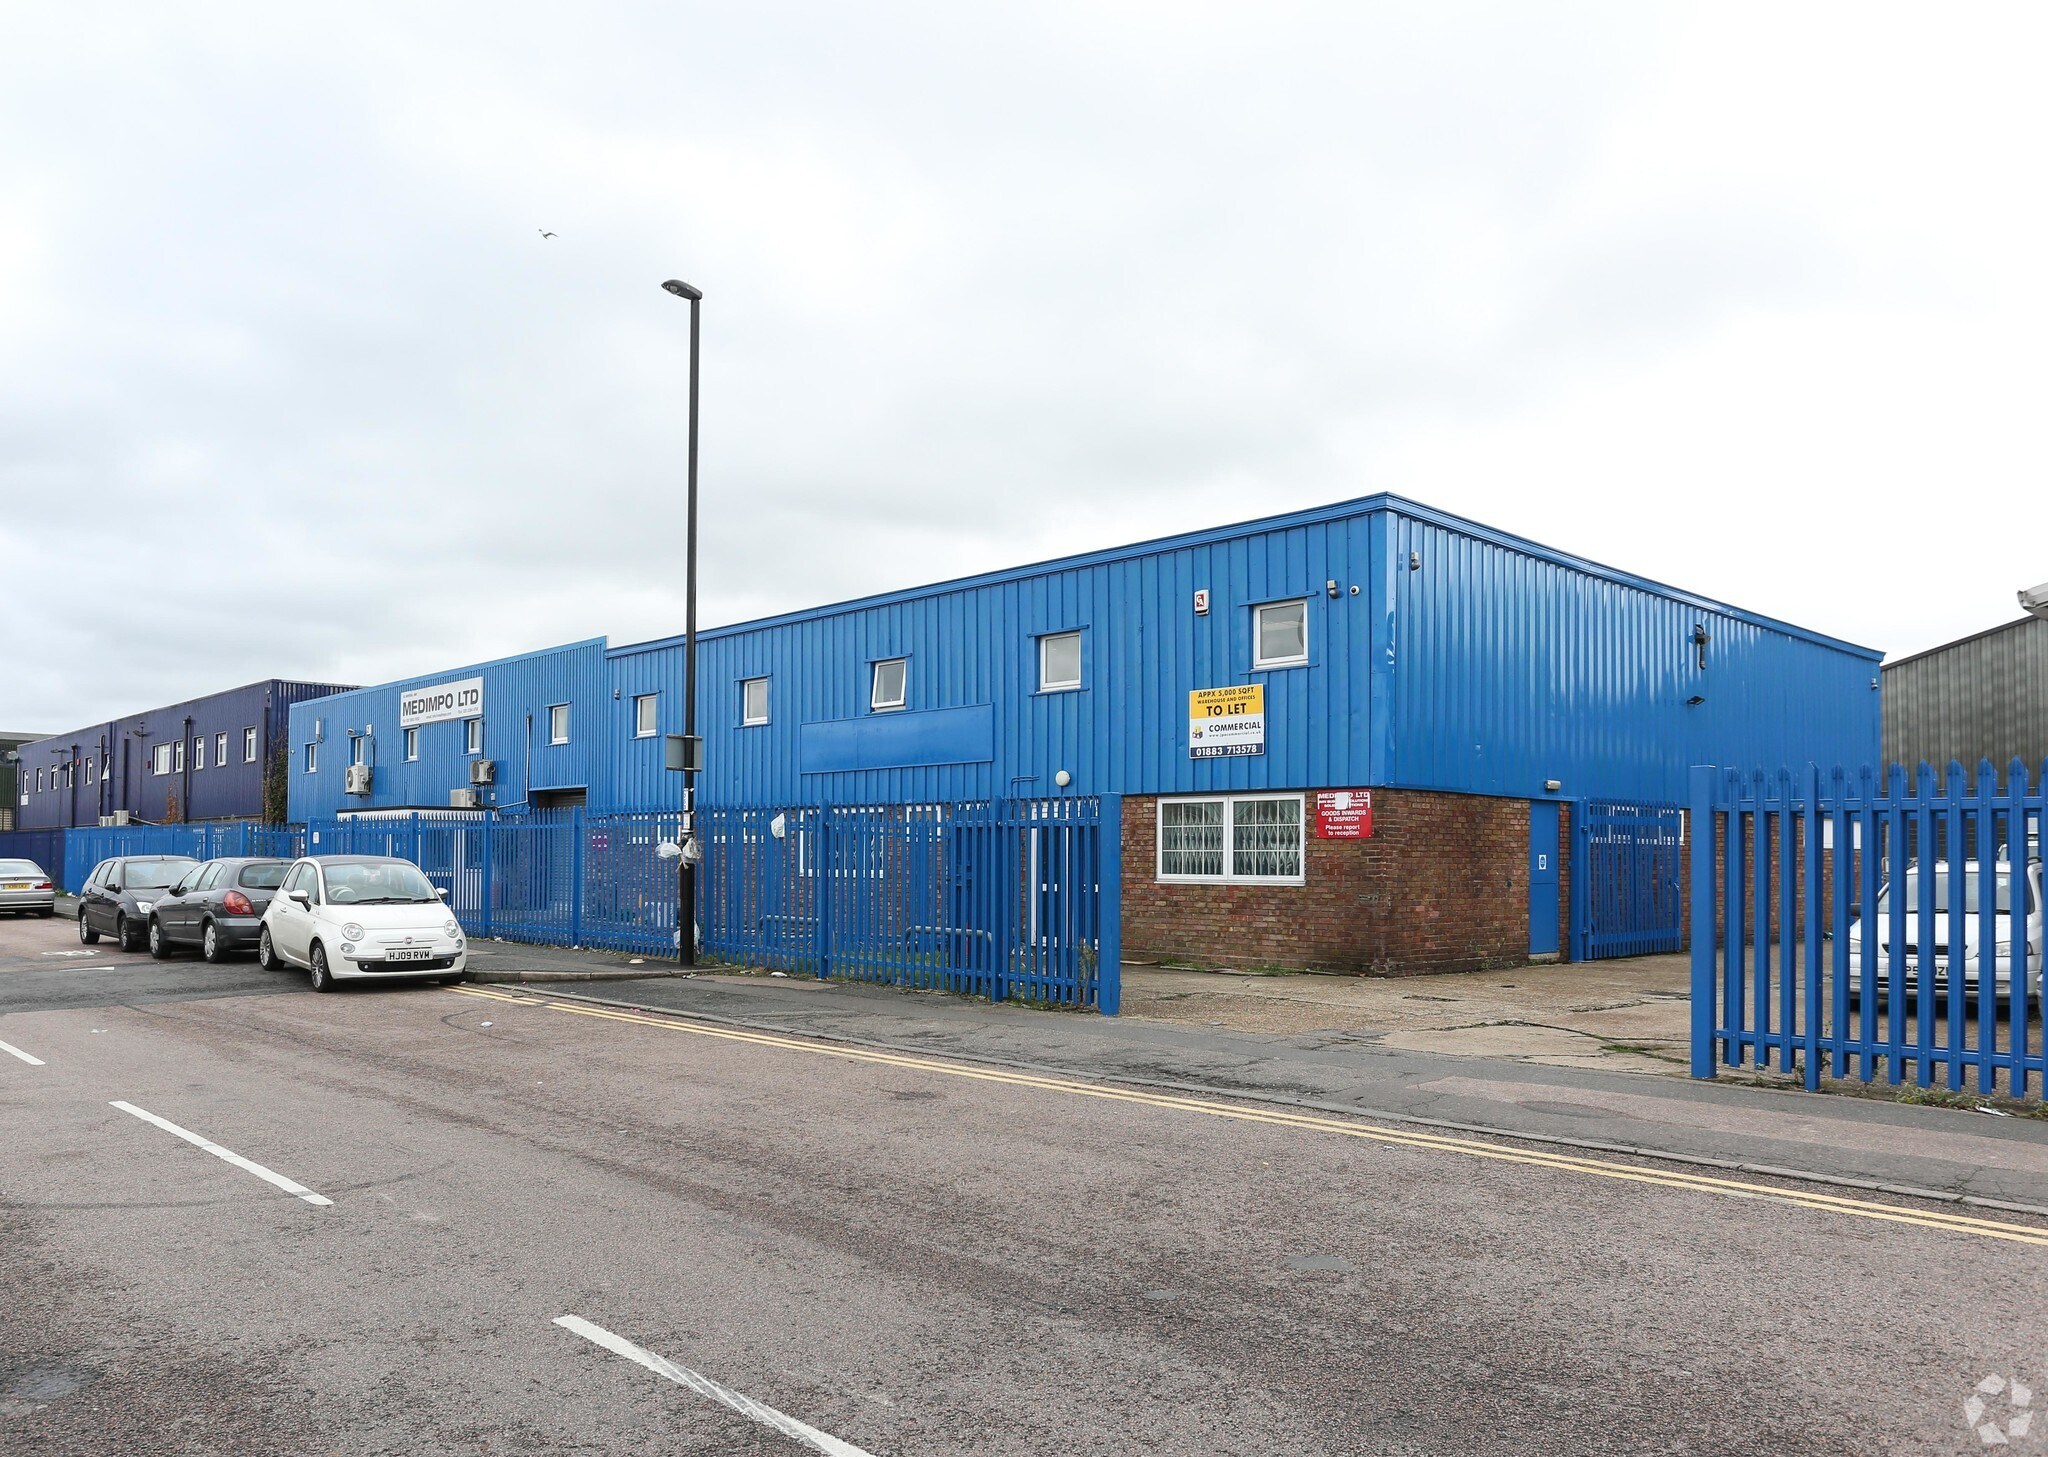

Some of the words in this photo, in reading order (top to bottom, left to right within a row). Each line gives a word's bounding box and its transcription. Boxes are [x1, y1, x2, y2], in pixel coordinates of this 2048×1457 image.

[1198, 690, 1216, 698] APPX
[1218, 689, 1237, 697] 5,000
[1238, 686, 1255, 694] SQFT
[403, 693, 453, 716] MEDIMPO
[458, 688, 479, 707] LTD
[1206, 705, 1223, 716] TO
[1228, 703, 1247, 715] LET
[1208, 721, 1262, 732] COMMERCIAL
[1196, 747, 1223, 756] 01883
[1226, 744, 1257, 755] 713578
[389, 951, 412, 960] HJ09
[413, 950, 430, 960] RVM
